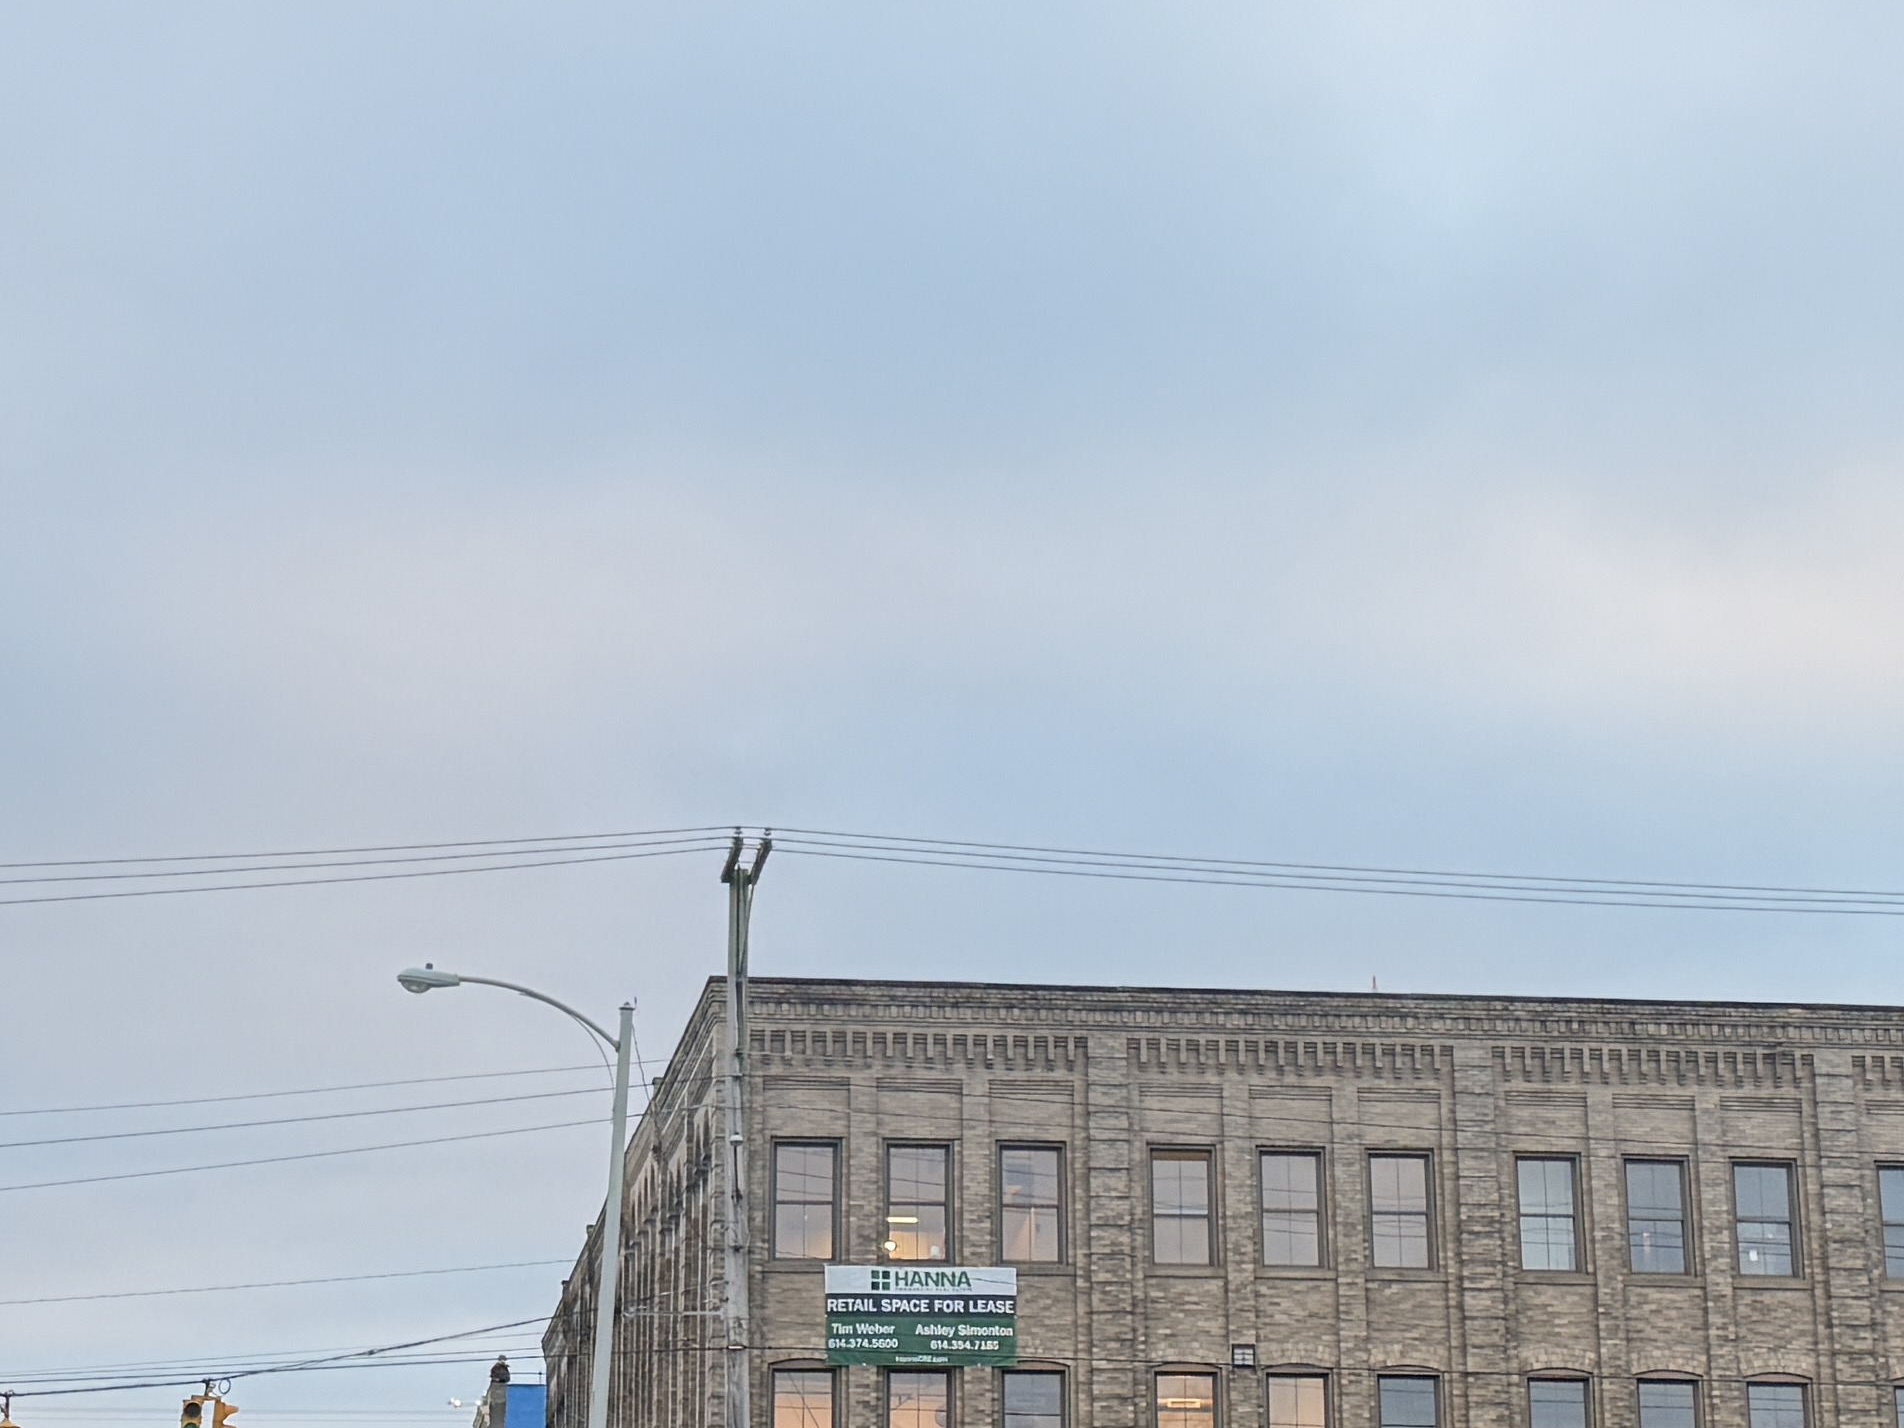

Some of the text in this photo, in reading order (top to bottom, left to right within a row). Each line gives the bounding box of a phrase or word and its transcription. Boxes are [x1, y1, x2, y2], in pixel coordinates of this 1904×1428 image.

[895, 1271, 972, 1288] HANNA
[827, 1298, 1015, 1314] RETAIL SPACE FOR LEASE
[831, 1323, 896, 1335] Tim Weber
[915, 1324, 1014, 1339] Ashley Simonton
